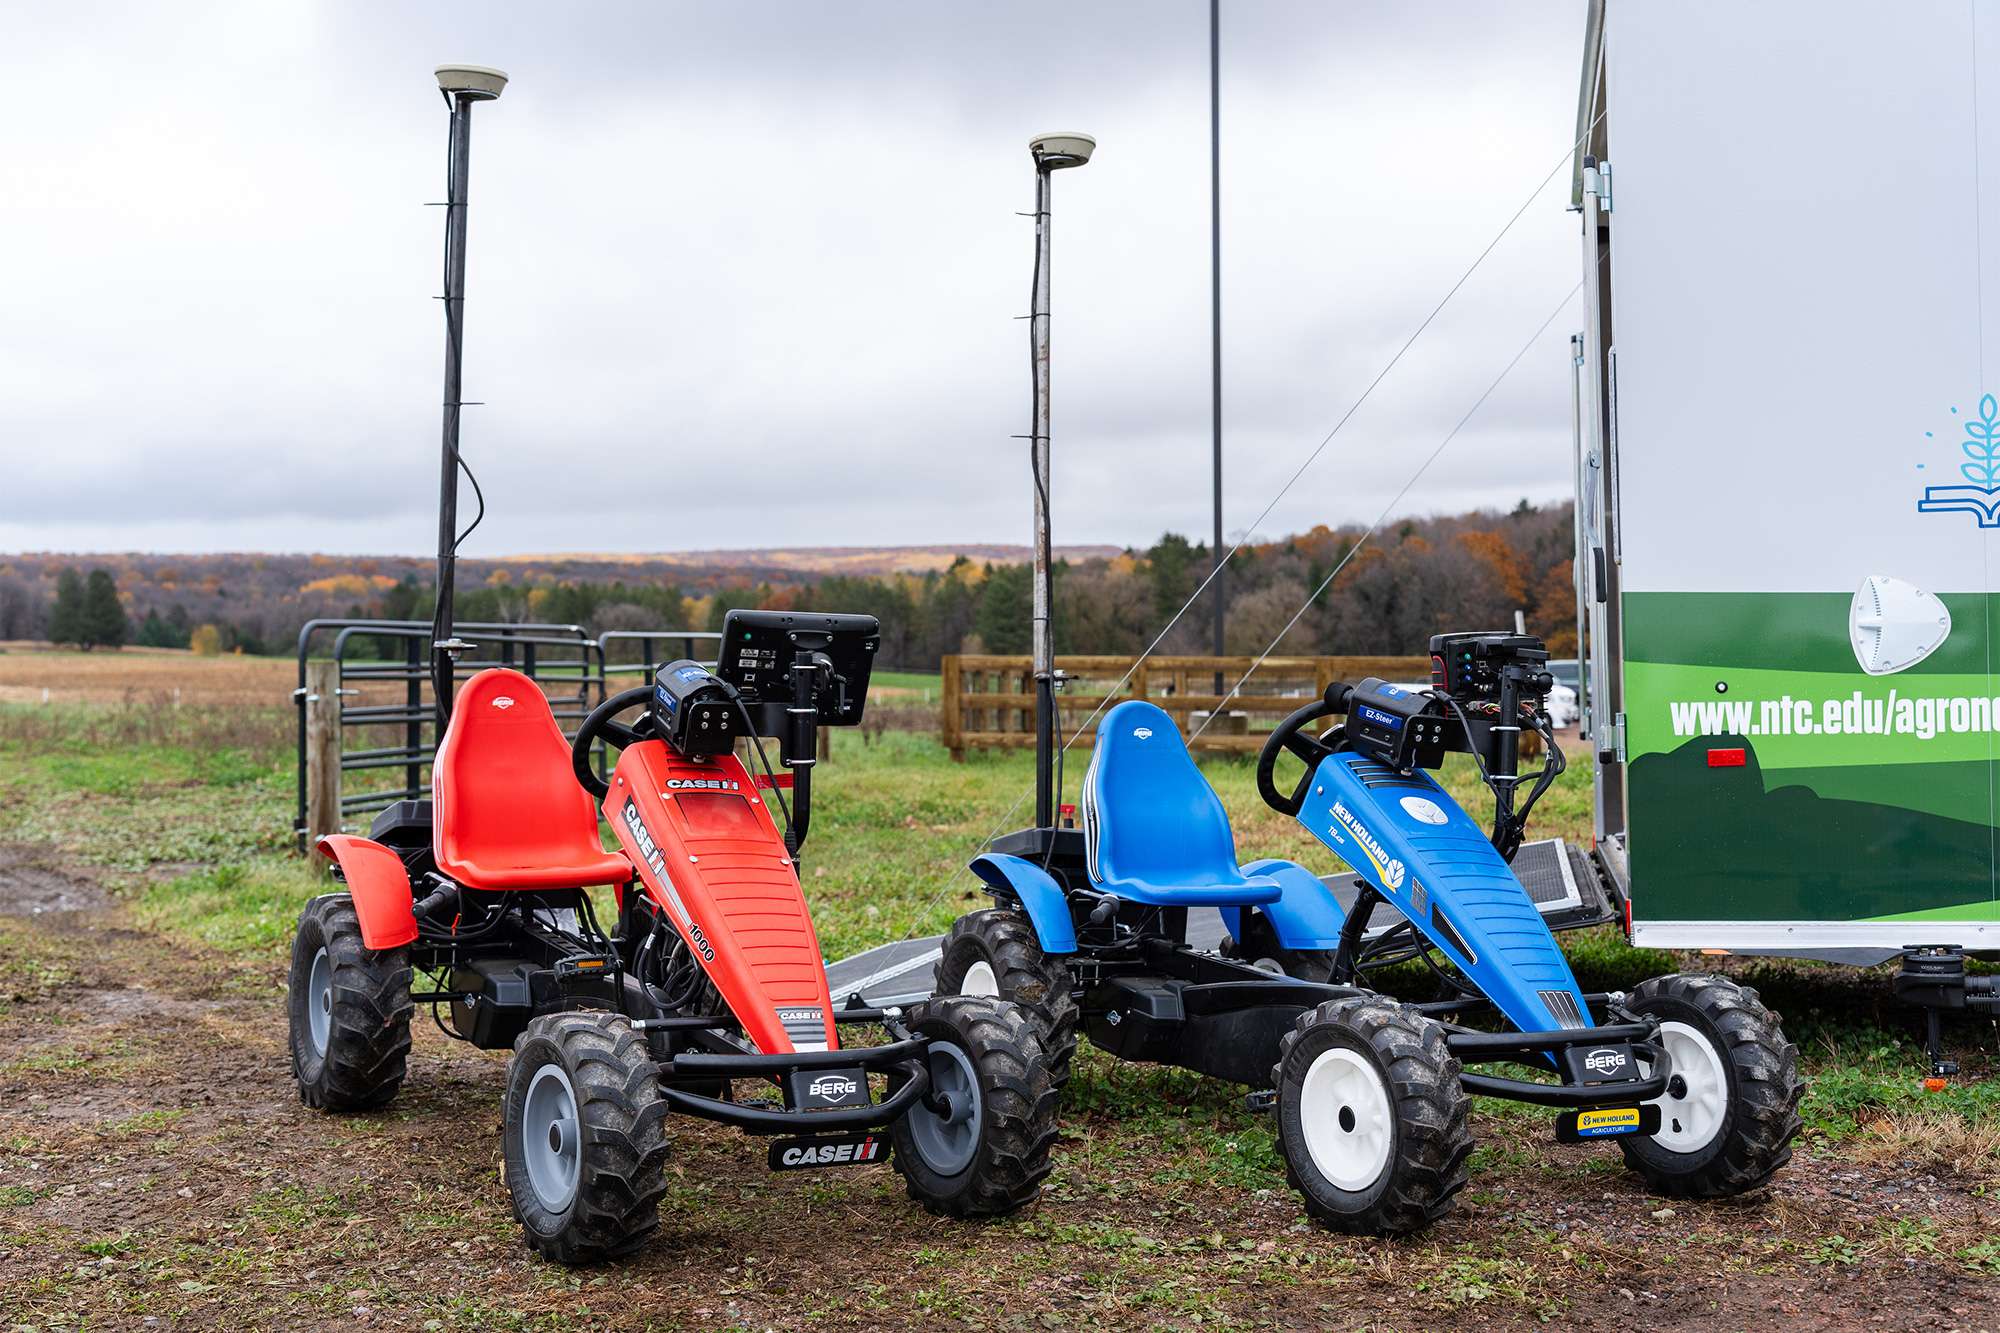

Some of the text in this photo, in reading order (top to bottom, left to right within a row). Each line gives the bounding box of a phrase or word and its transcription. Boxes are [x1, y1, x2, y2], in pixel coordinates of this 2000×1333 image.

[1365, 709, 1393, 725] EZ-Steer
[666, 779, 721, 789] CASE
[625, 803, 655, 858] CASE
[1332, 801, 1390, 865] NEW HOLLAND
[688, 923, 715, 963] 1000
[780, 1011, 811, 1020] CASE
[1585, 1054, 1626, 1069] BERG
[809, 1081, 857, 1096] BERG
[1592, 1114, 1635, 1124] NEW HOLLAND
[1591, 1126, 1625, 1135] AGRICULTURE
[782, 1144, 854, 1167] CASE
